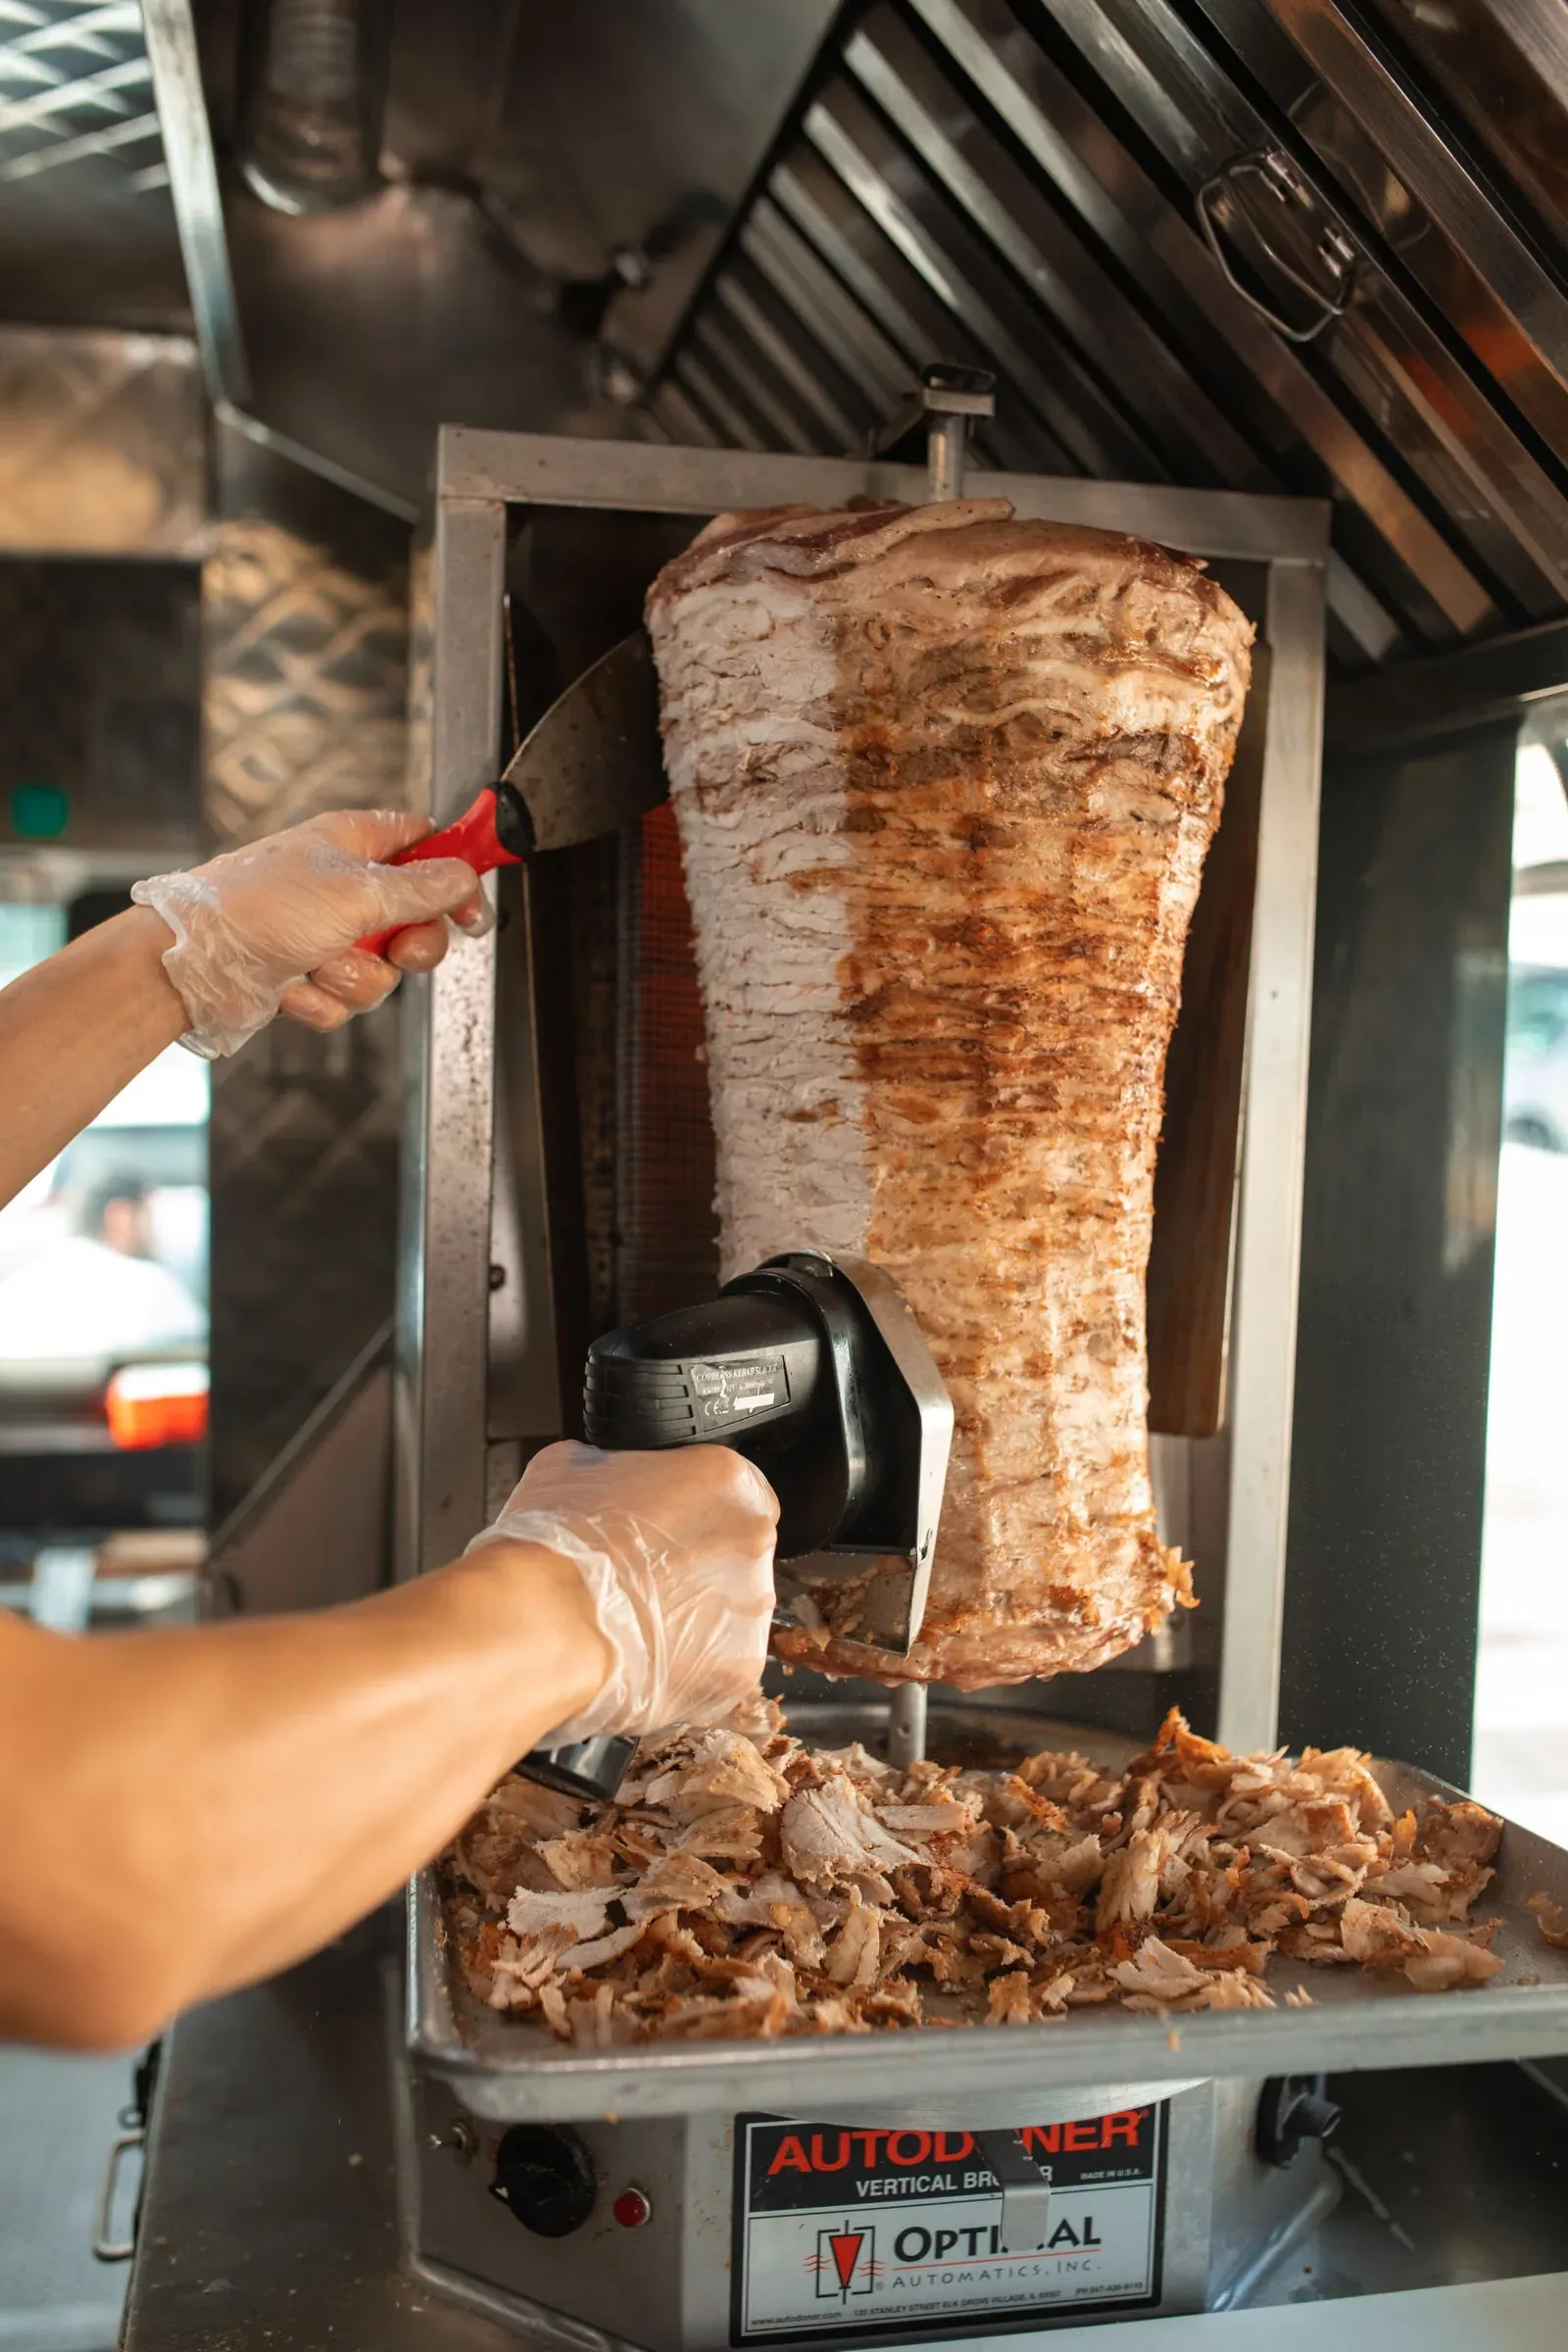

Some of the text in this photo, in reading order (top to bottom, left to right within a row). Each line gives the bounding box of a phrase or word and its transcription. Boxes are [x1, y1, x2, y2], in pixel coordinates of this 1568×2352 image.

[766, 2109, 1141, 2175] AUTODNER
[1079, 2171, 1105, 2180] MADE
[1106, 2170, 1116, 2179] IN
[856, 2174, 958, 2198] VERTICAL
[893, 2216, 1102, 2263] OPTIAL
[1056, 2259, 1102, 2275] INC.
[868, 2305, 906, 2316] STANLEY
[907, 2301, 942, 2313] STREET
[751, 2312, 842, 2326] www.autodoner.com
